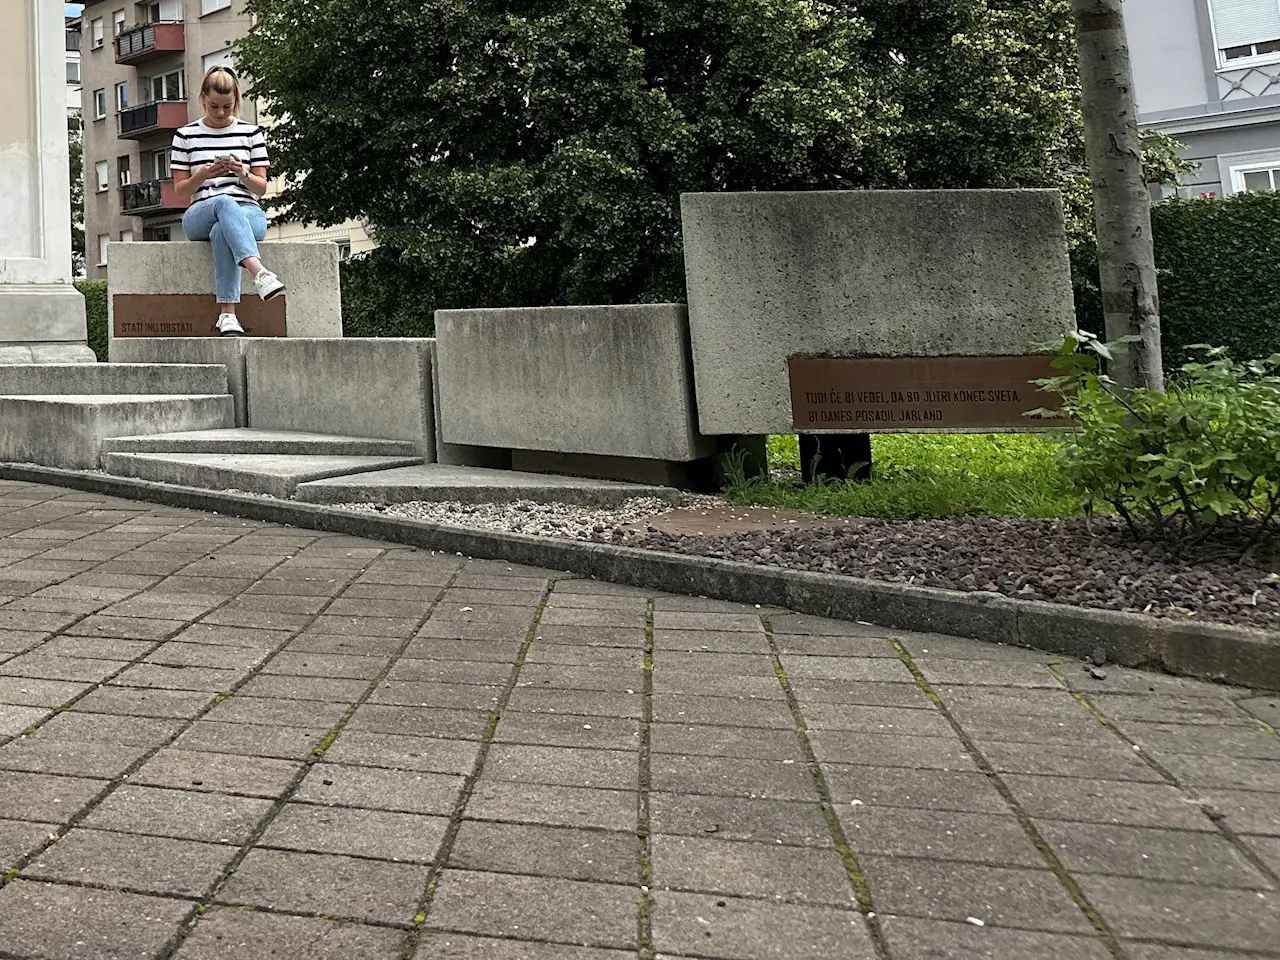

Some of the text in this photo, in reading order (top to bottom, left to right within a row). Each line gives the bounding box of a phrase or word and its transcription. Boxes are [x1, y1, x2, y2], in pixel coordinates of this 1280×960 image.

[121, 322, 143, 333] STATI
[160, 322, 192, 333] OBSTATI
[805, 392, 827, 404] TUDI
[845, 392, 854, 403] BI
[891, 391, 904, 402] DA
[907, 391, 920, 402] BO
[923, 391, 951, 403] JUTRI
[954, 390, 985, 402] KONEC
[808, 409, 942, 422] BI DANES POSADIL JABLANO
